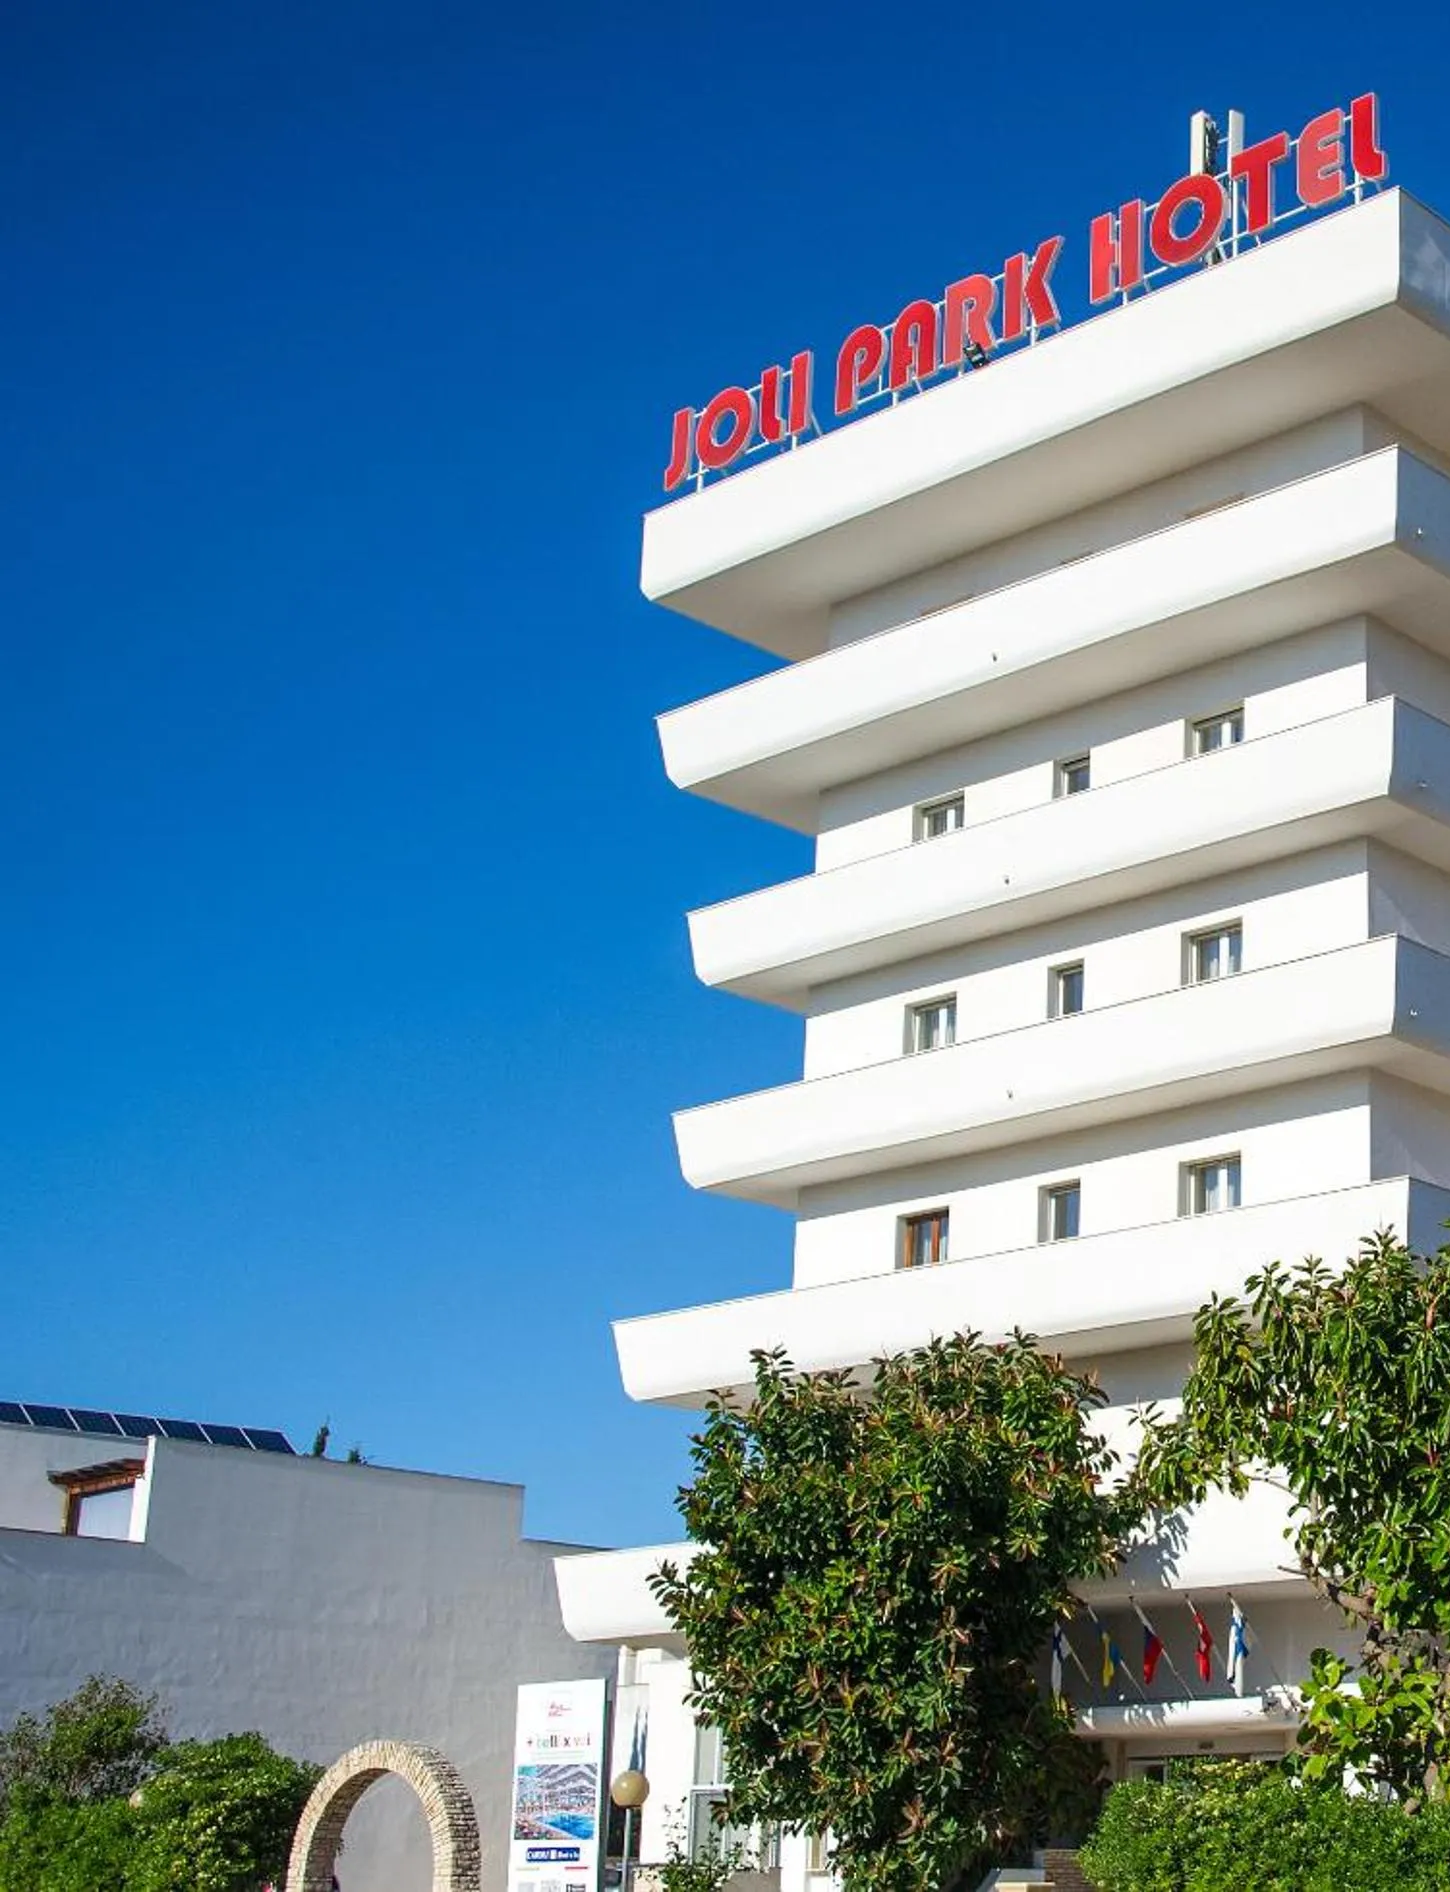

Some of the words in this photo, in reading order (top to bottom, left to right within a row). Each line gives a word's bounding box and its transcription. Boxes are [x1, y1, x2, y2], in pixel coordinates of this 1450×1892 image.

[663, 350, 814, 493] JOLI
[834, 235, 1063, 415] PARK
[1089, 91, 1388, 304] HOTEL
